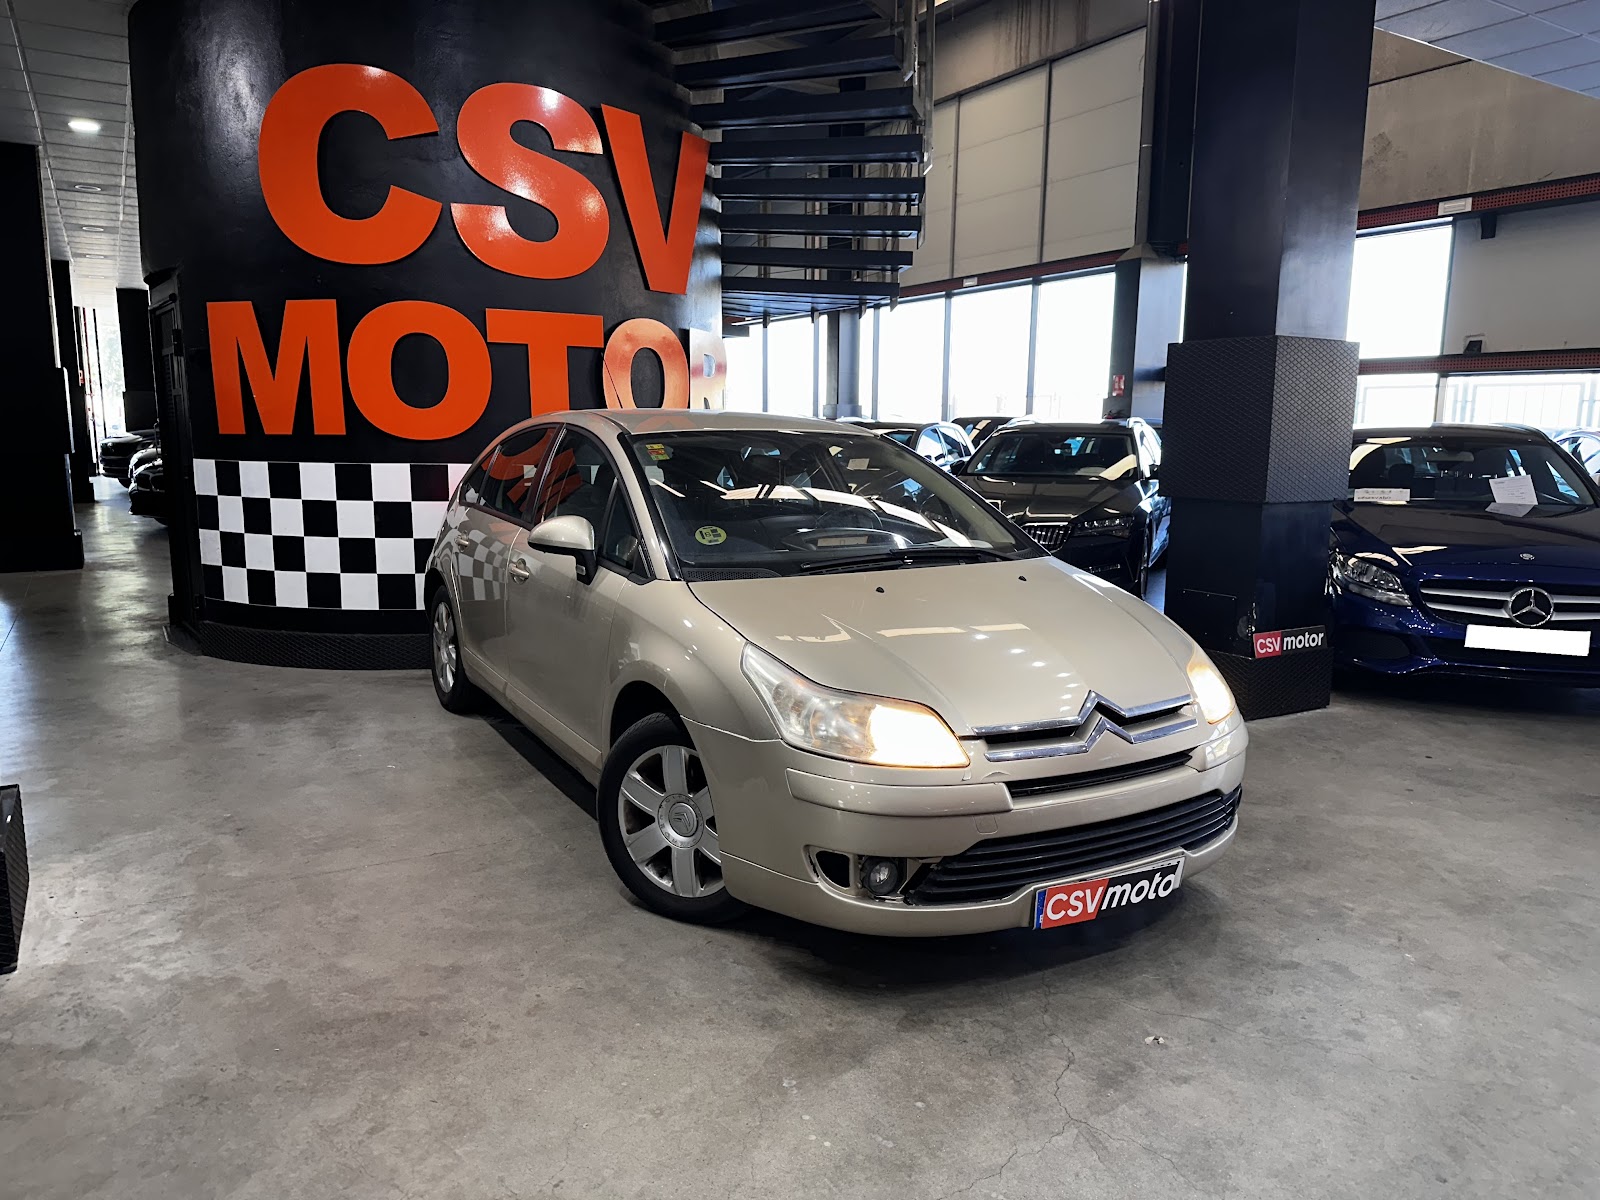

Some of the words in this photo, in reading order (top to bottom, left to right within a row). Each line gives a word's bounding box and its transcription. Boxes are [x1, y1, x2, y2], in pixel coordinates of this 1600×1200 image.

[258, 63, 711, 295] CSV
[206, 298, 727, 441] MOTOR
[1256, 636, 1281, 654] CSV
[1283, 631, 1324, 651] motor
